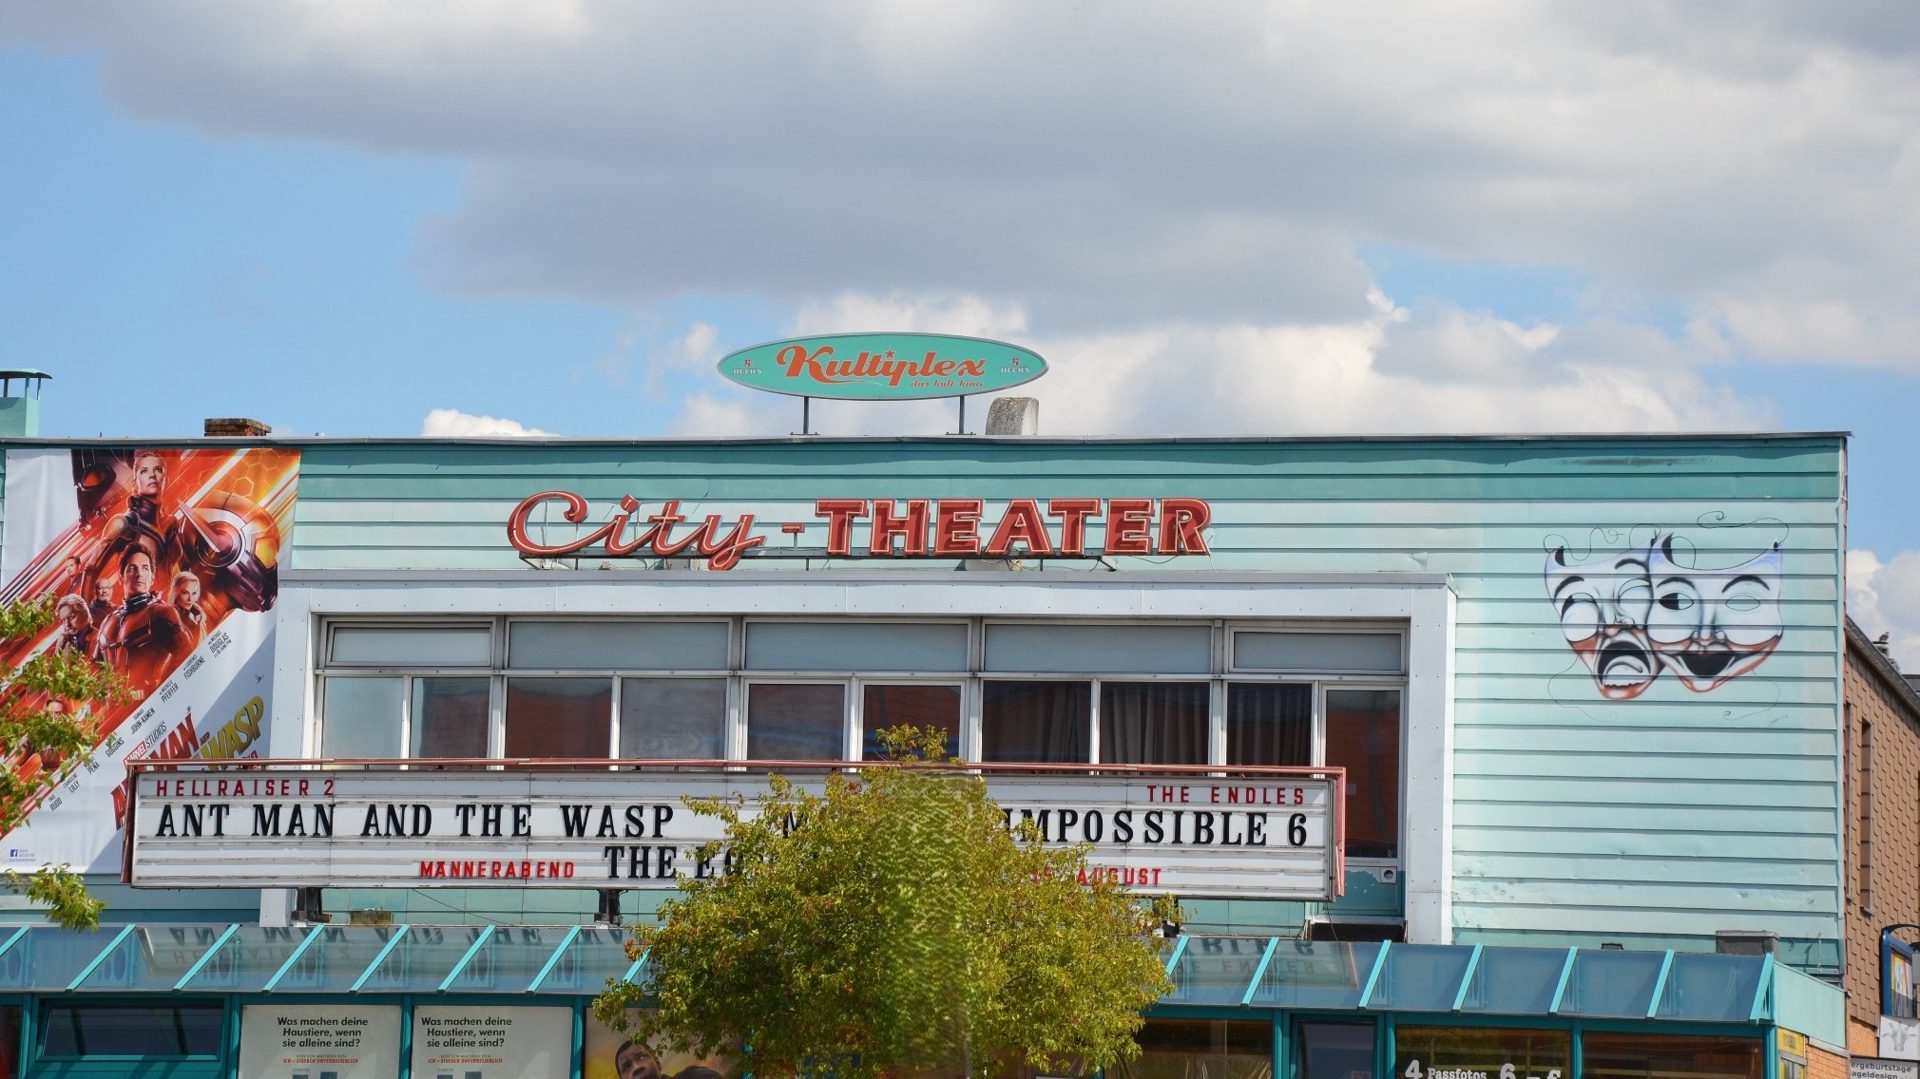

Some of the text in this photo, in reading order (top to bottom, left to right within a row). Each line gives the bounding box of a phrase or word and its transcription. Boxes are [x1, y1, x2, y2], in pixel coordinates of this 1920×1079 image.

[776, 345, 986, 387] Kultiplex
[507, 490, 767, 572] City
[815, 496, 1212, 557] THEATER
[156, 779, 334, 797] HELLRAISER 2
[1146, 784, 1304, 806] THE ENDLES
[155, 803, 674, 838] ANT MAN AND THE WASP
[1288, 812, 1307, 846] 6
[604, 845, 677, 879] THE
[277, 1017, 369, 1026] Was machen deine
[421, 1017, 512, 1026] Was machen deine
[282, 1028, 362, 1038] Haustiere, wenn
[427, 1028, 506, 1038] Haustiere, wenn
[282, 1038, 361, 1048] sie alleine sind?
[427, 1038, 505, 1048] sie alleine sind?
[1405, 1059, 1424, 1079] 4
[1427, 1067, 1488, 1079] Passfotos
